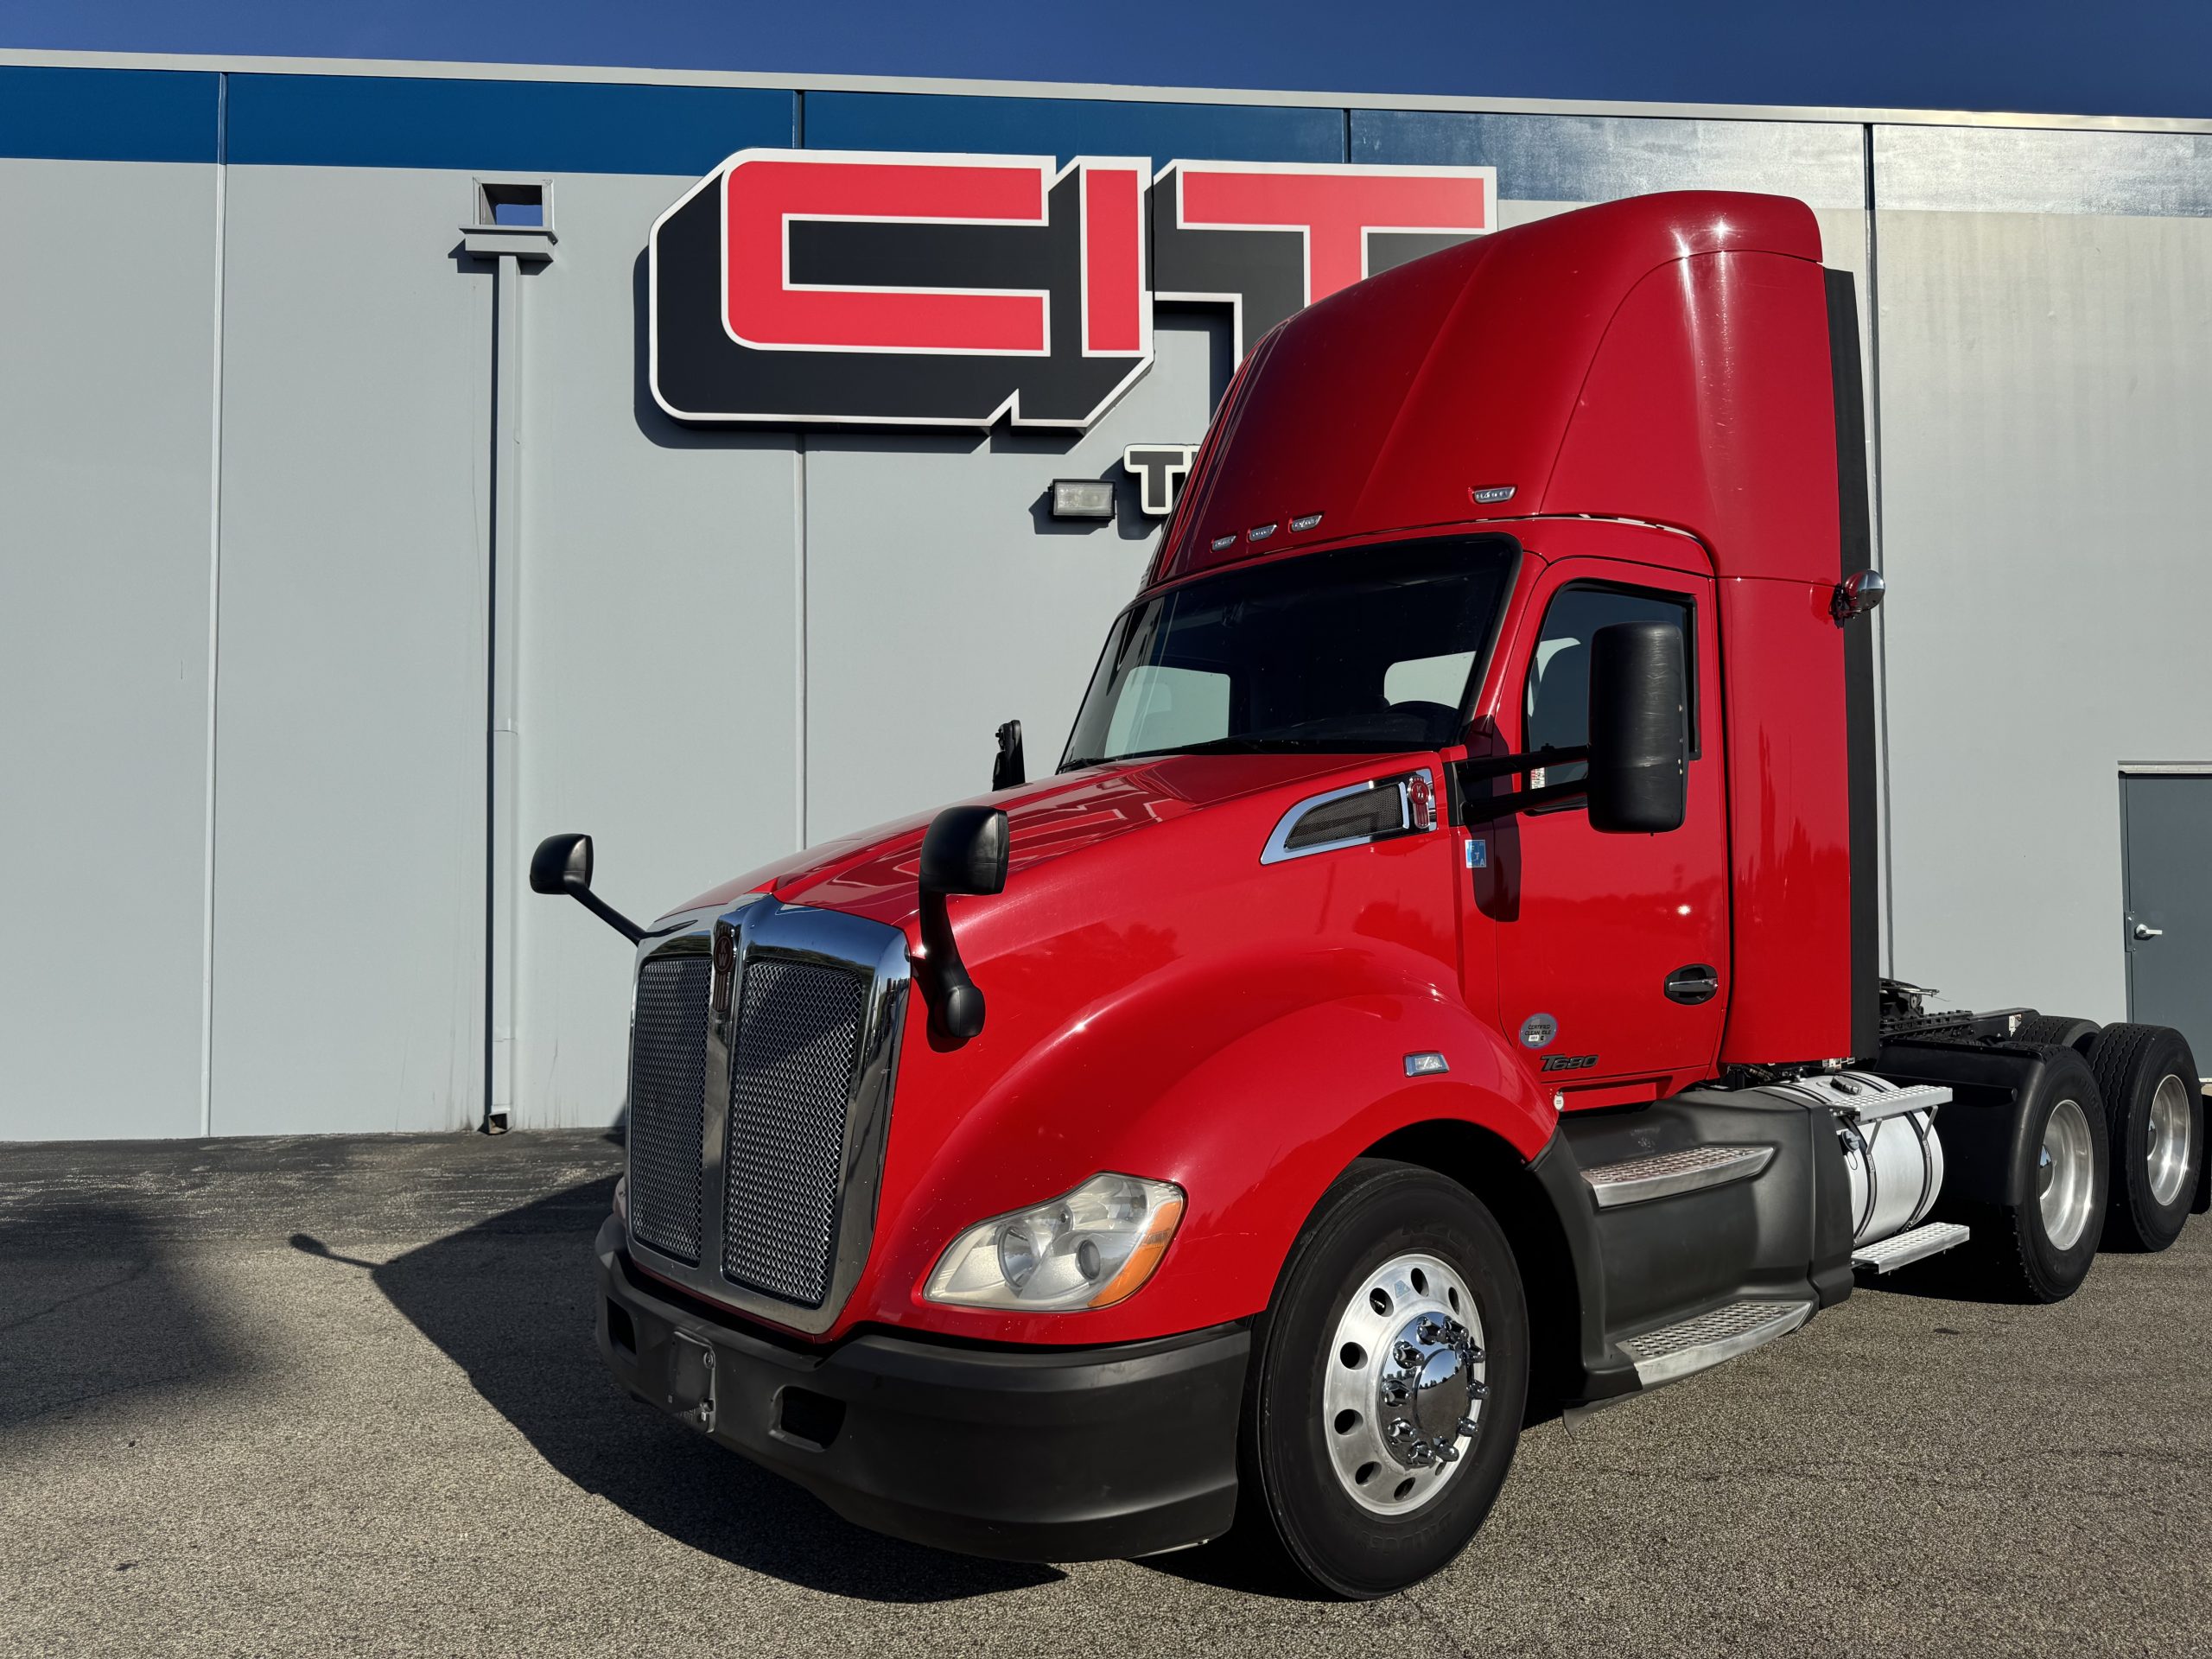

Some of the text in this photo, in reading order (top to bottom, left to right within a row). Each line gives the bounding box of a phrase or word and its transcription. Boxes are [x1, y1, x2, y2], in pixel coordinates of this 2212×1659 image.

[649, 148, 1497, 428] CIT
[1124, 444, 1201, 514] T
[1541, 1053, 1599, 1071] T680
